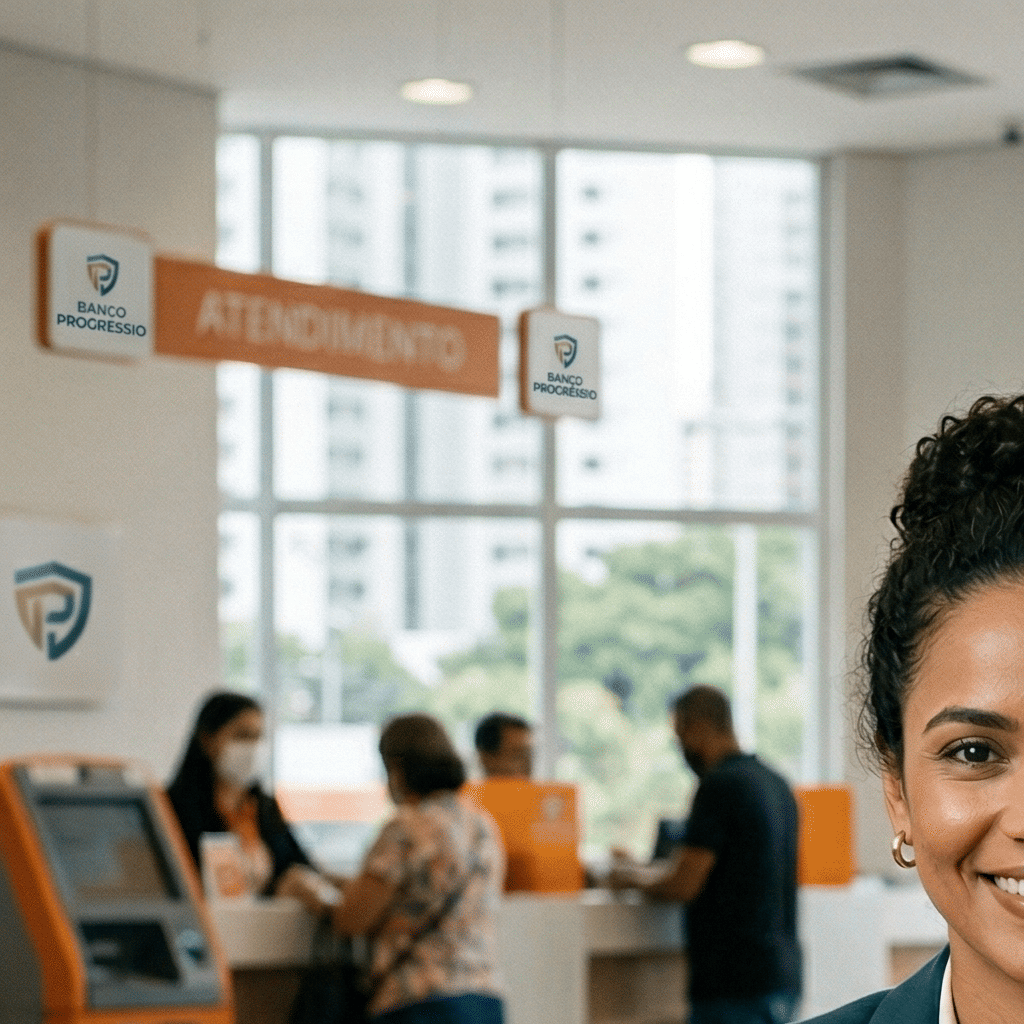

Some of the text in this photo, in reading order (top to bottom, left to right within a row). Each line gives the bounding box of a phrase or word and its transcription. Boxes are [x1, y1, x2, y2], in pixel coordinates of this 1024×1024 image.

[77, 301, 127, 319] BANCO
[196, 289, 468, 372] ATENDIMENTO
[547, 372, 583, 386] BANCO
